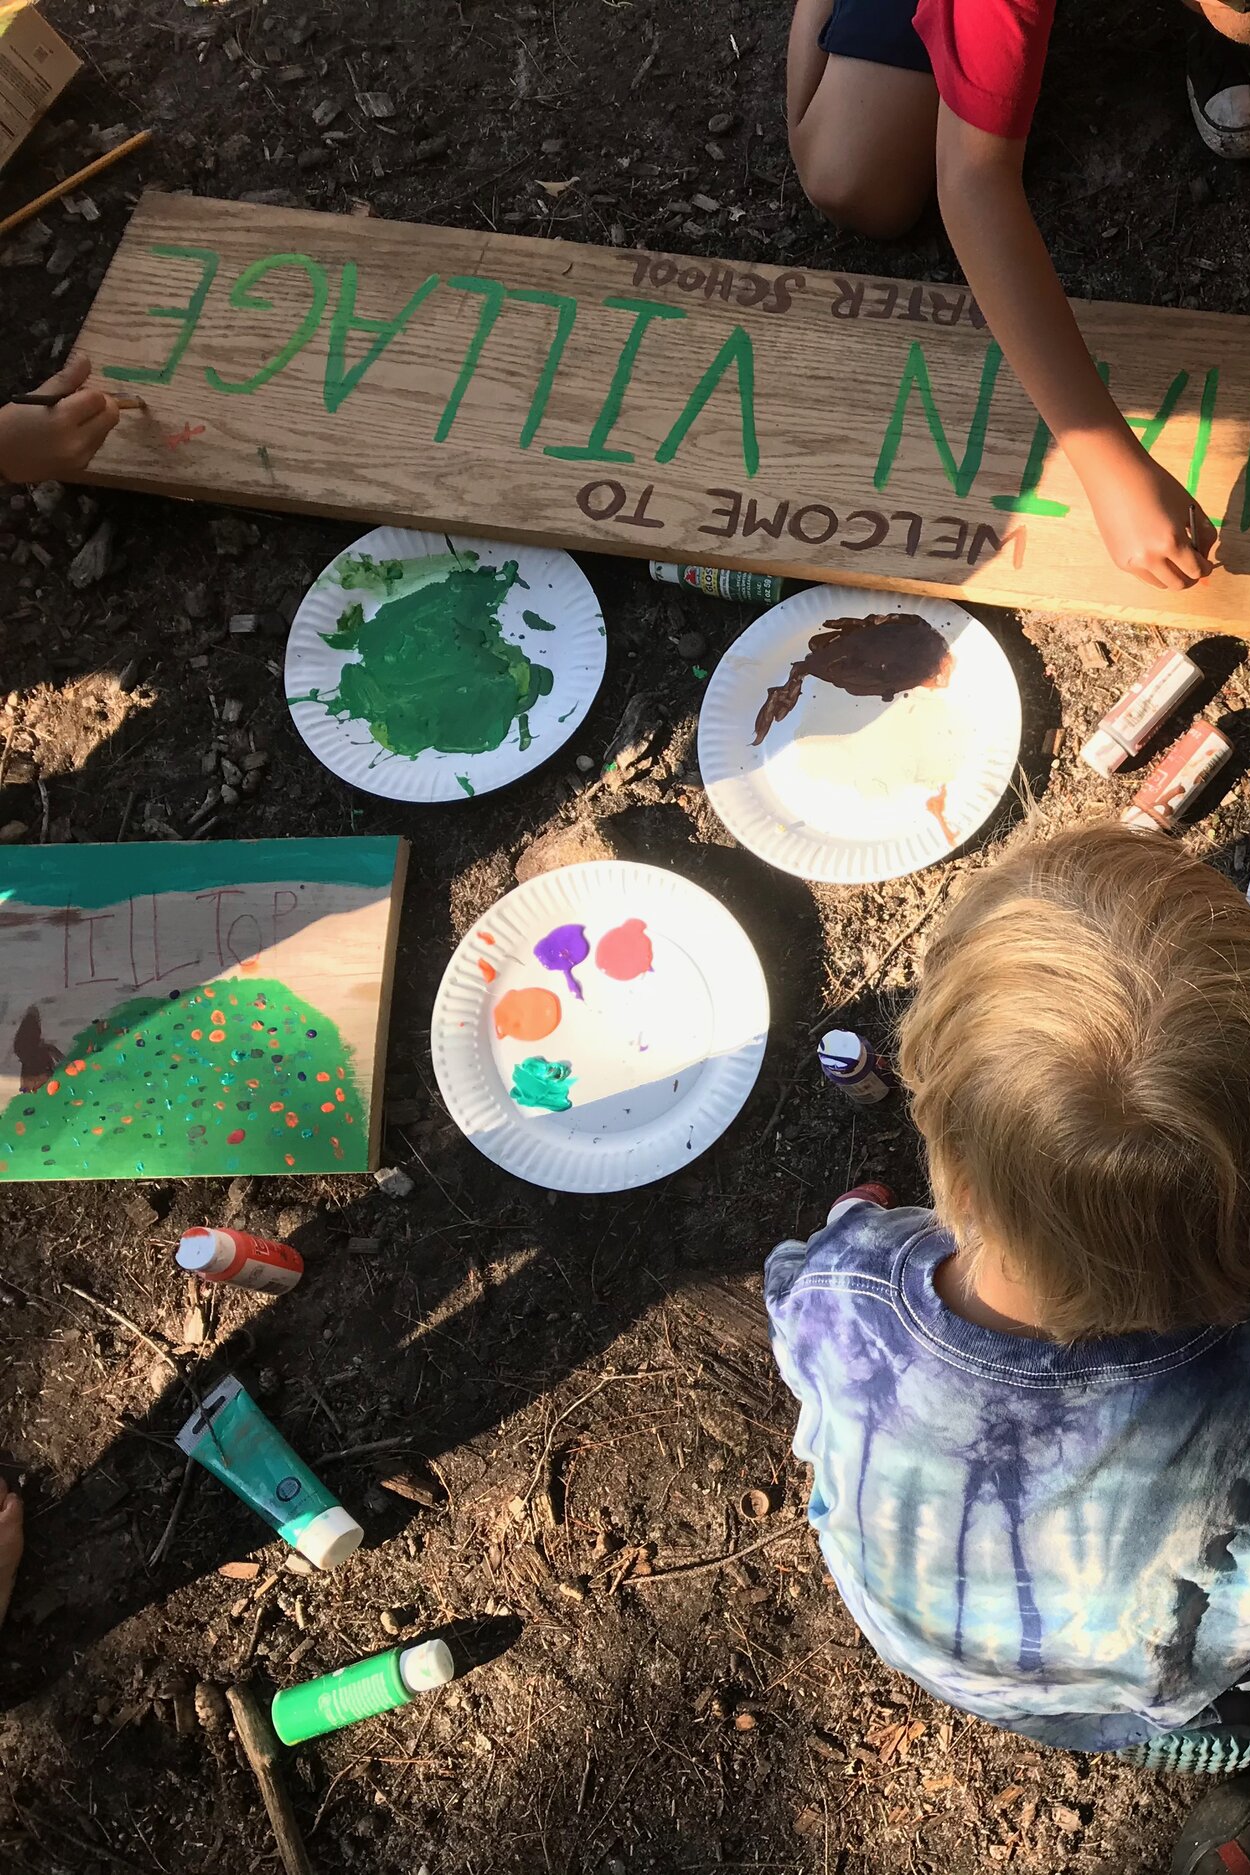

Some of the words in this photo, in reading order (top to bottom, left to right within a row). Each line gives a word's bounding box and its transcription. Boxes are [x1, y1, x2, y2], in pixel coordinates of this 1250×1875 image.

[616, 254, 806, 314] SCHOOL
[102, 243, 761, 479] VILLAGE
[576, 479, 664, 529] TO
[698, 487, 1028, 569] WELCOME
[705, 566, 714, 593] GLOS
